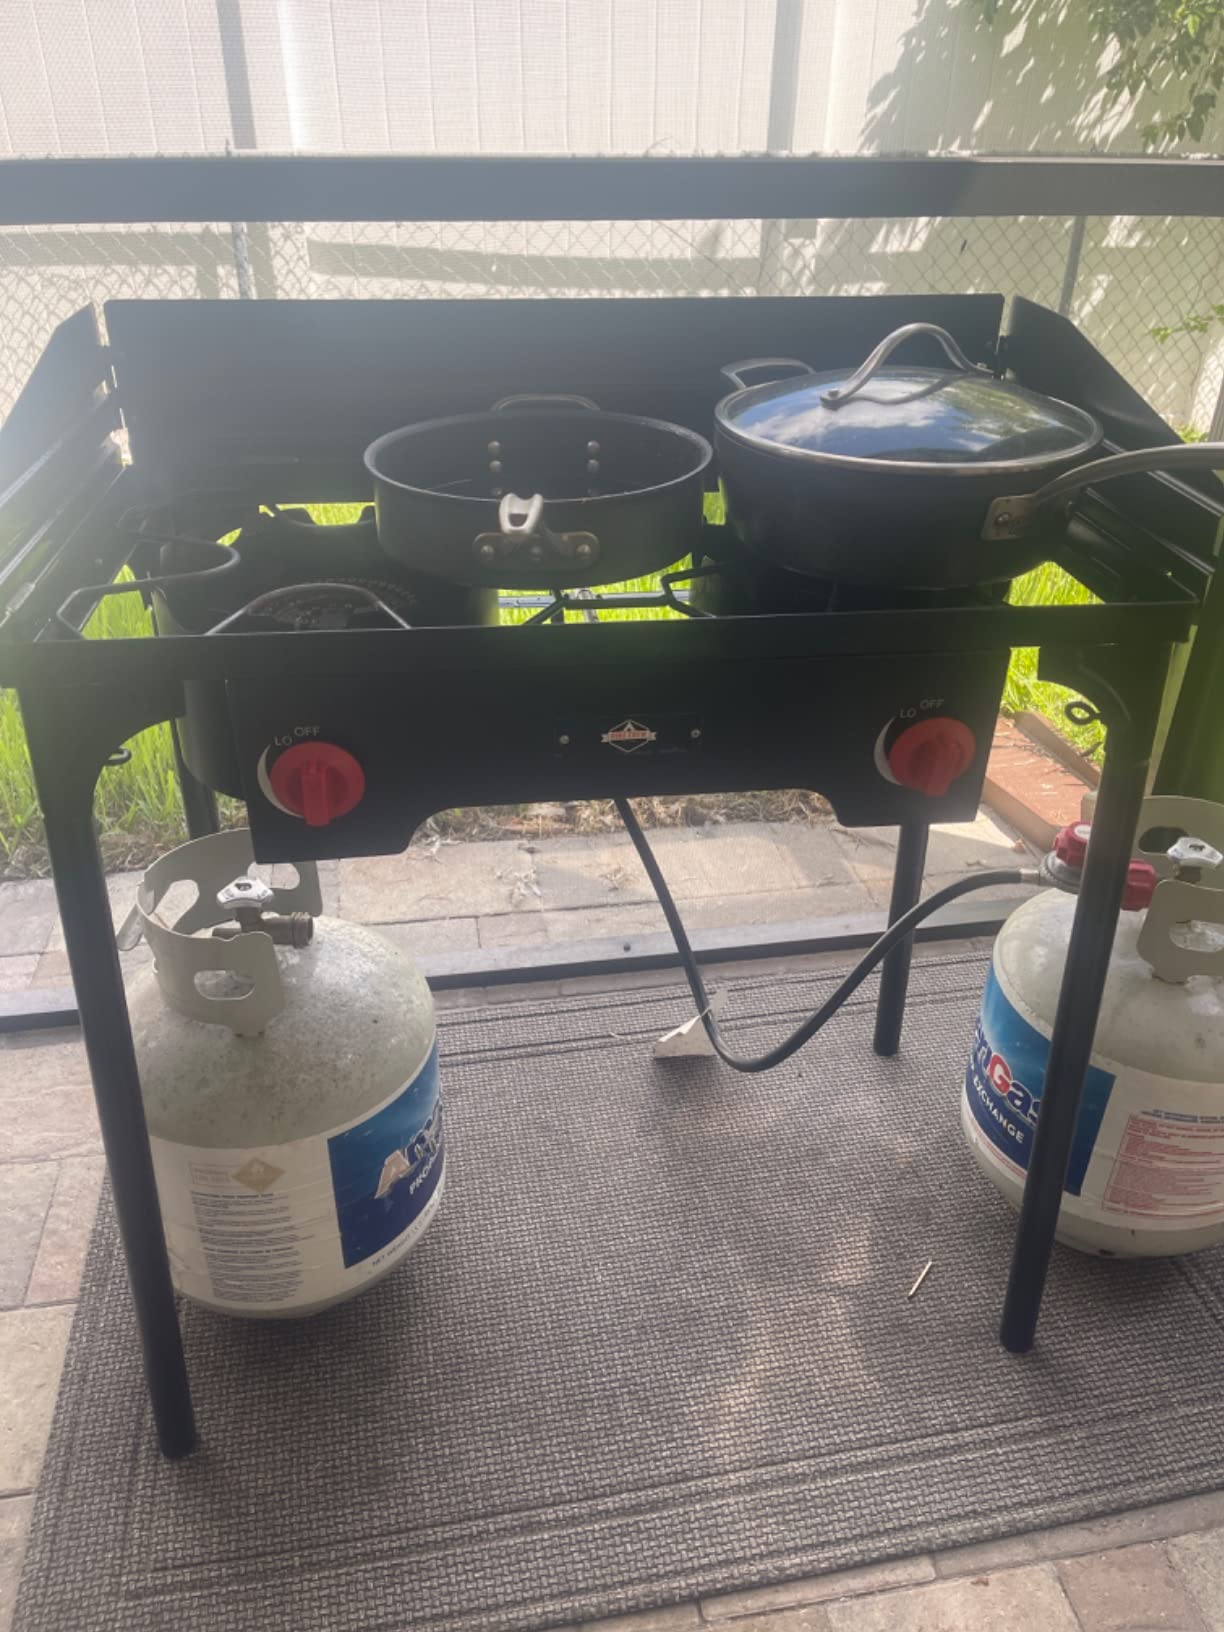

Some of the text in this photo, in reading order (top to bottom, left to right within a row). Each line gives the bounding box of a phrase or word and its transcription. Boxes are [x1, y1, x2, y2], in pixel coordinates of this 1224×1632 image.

[900, 698, 945, 719] LO OFF
[274, 725, 320, 747] LO OFF
[972, 1073, 1025, 1144] EXCHANGE
